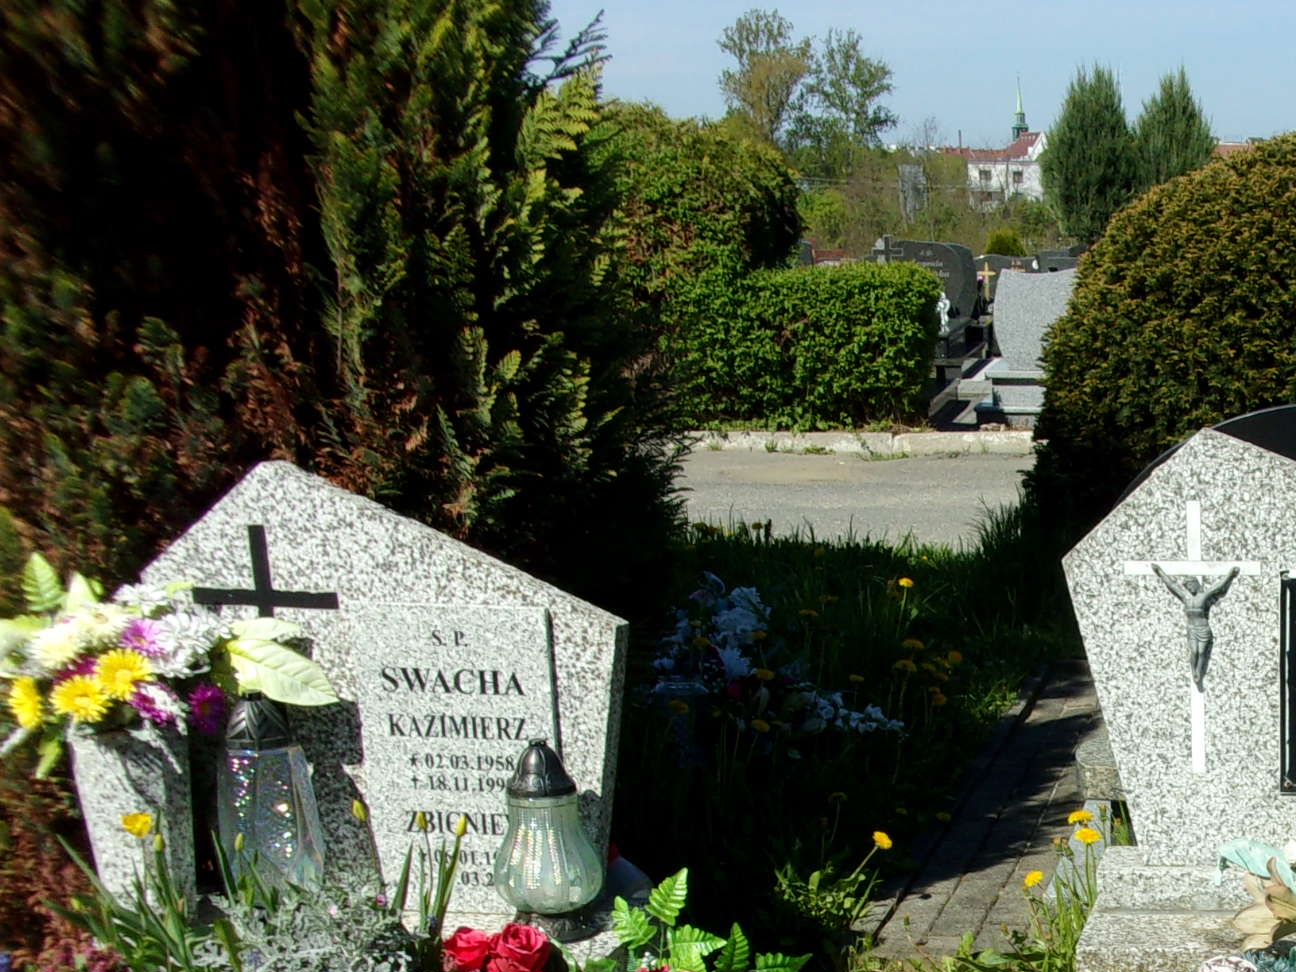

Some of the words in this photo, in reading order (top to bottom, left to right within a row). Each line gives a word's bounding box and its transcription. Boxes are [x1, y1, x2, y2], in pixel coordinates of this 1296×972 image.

[381, 667, 526, 696] SWACHA
[387, 713, 530, 741] KAZIMIERZ
[425, 752, 515, 772] 02.03.1958
[429, 774, 508, 793] 18.11.199
[406, 810, 509, 835] ZBIGNIE
